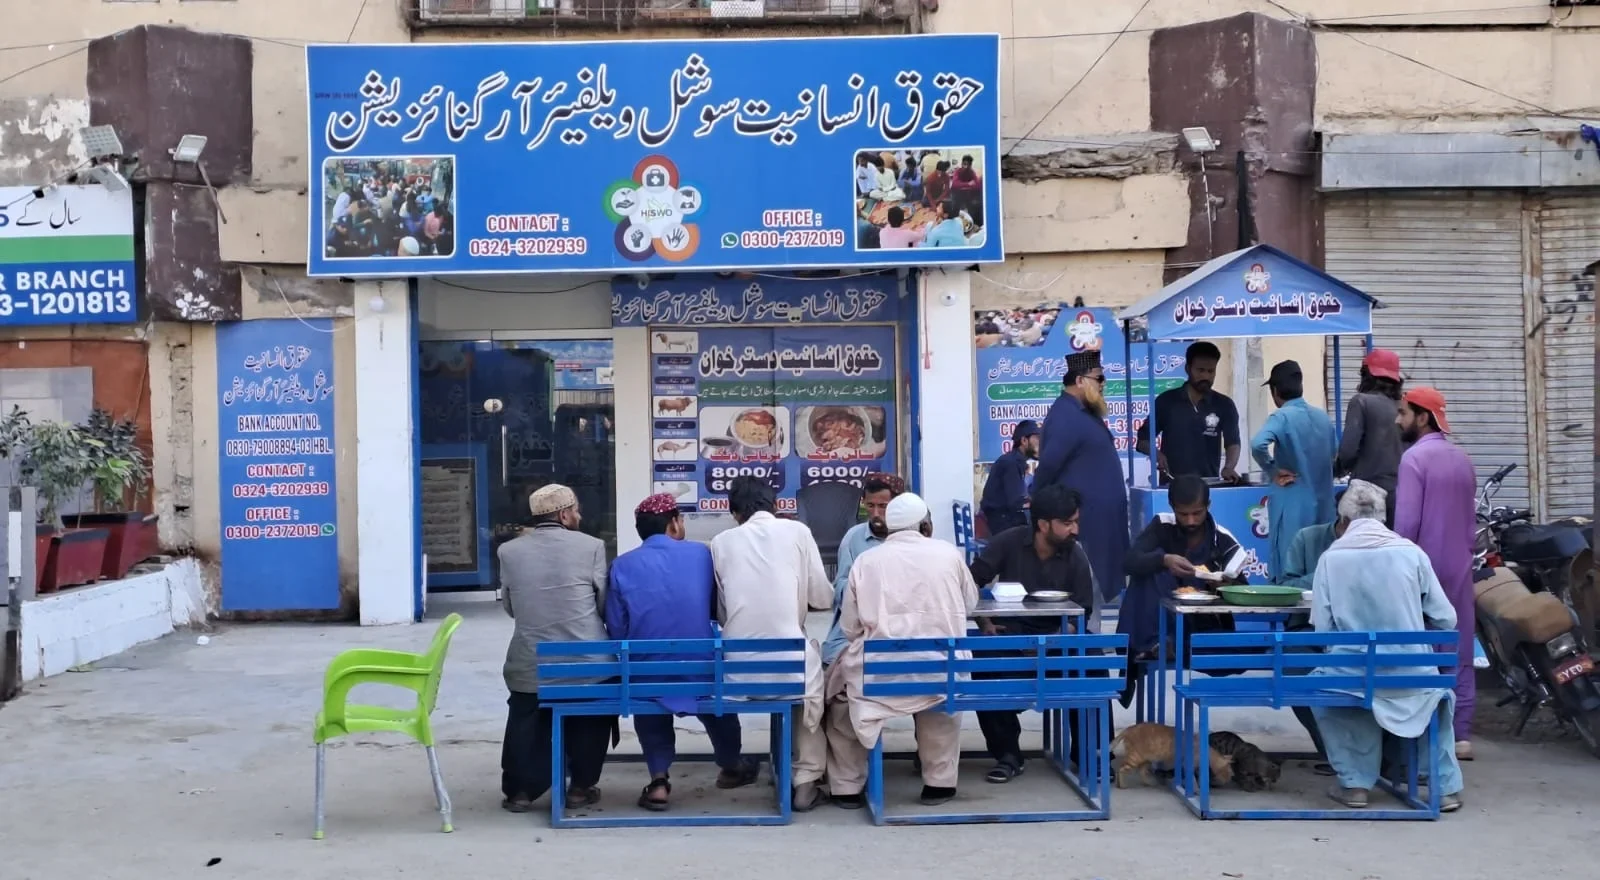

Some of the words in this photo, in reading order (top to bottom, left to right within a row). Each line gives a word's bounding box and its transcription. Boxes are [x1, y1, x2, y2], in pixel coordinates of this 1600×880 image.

[637, 53, 740, 148] سوشل
[734, 74, 878, 145] انسانیت
[880, 69, 984, 142] حقوق
[49, 198, 81, 229] سال
[487, 213, 560, 232] CONTACT
[640, 208, 673, 218] HISWO
[762, 209, 813, 228] OFFICE
[469, 236, 588, 257] 0324-3202939
[741, 229, 844, 248] 0300-2372019
[16, 269, 124, 290] BRANCH
[728, 282, 776, 323] سوشل
[839, 289, 888, 321] حقوق
[1249, 293, 1306, 321] انسانیت
[1307, 291, 1342, 320] حقوق
[244, 346, 284, 372] انسانیت
[284, 345, 311, 371] حقوق
[780, 344, 842, 376] انسانیت
[842, 344, 882, 376] حقوق
[306, 369, 336, 404] سوشل
[238, 415, 262, 432] BANK
[263, 413, 304, 432] ACCOUNT
[304, 413, 321, 431] NO.
[990, 404, 1016, 420] BANK
[226, 438, 312, 456] 0830-79008894-03
[247, 463, 306, 478] CONTACT
[711, 466, 780, 479] 8000/-
[807, 466, 875, 478] 6000/-
[233, 482, 328, 498] 0324-3202939
[246, 506, 291, 521] OFFICE
[225, 524, 319, 539] 0300-2372019
